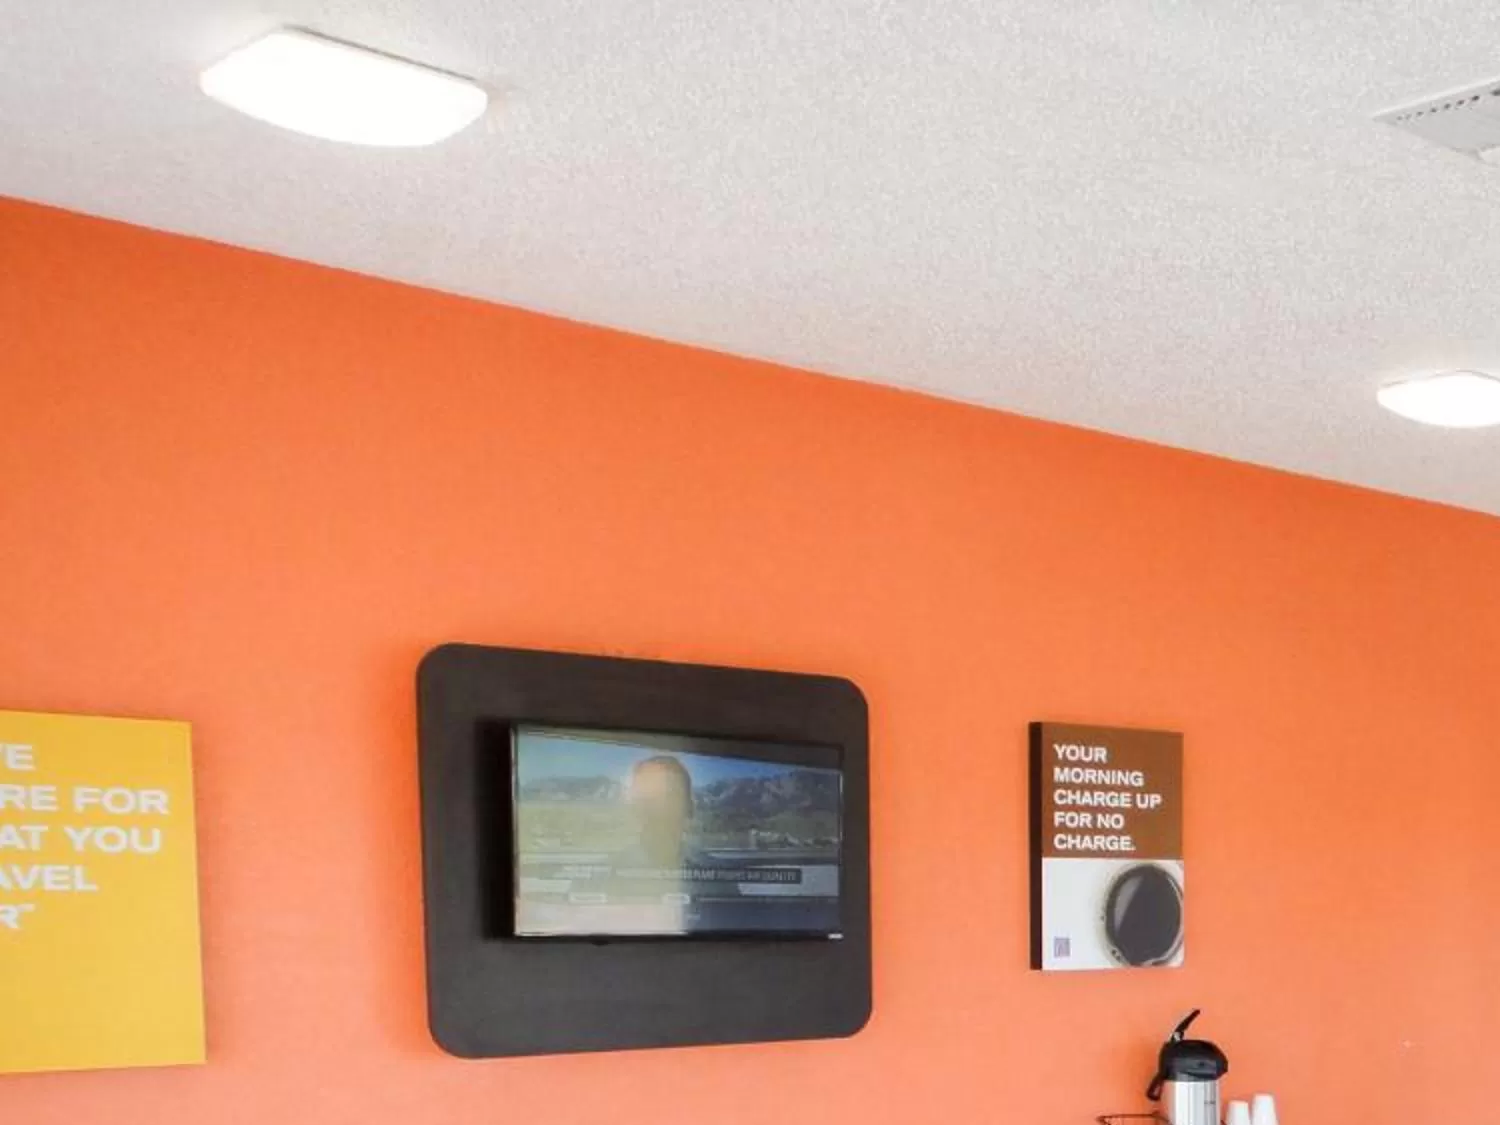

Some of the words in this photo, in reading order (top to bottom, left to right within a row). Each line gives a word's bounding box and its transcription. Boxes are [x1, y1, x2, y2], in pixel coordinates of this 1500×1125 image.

[0, 743, 35, 771] E
[1053, 744, 1107, 763] YOUR
[1053, 767, 1144, 787] MORNING
[73, 786, 170, 815] FOR
[1053, 789, 1132, 808] CHARGE
[1136, 793, 1161, 809] UP
[1053, 811, 1092, 829] FOR
[1097, 813, 1124, 829] NO
[65, 826, 161, 854] YOU
[1053, 833, 1136, 851] CHARGE.
